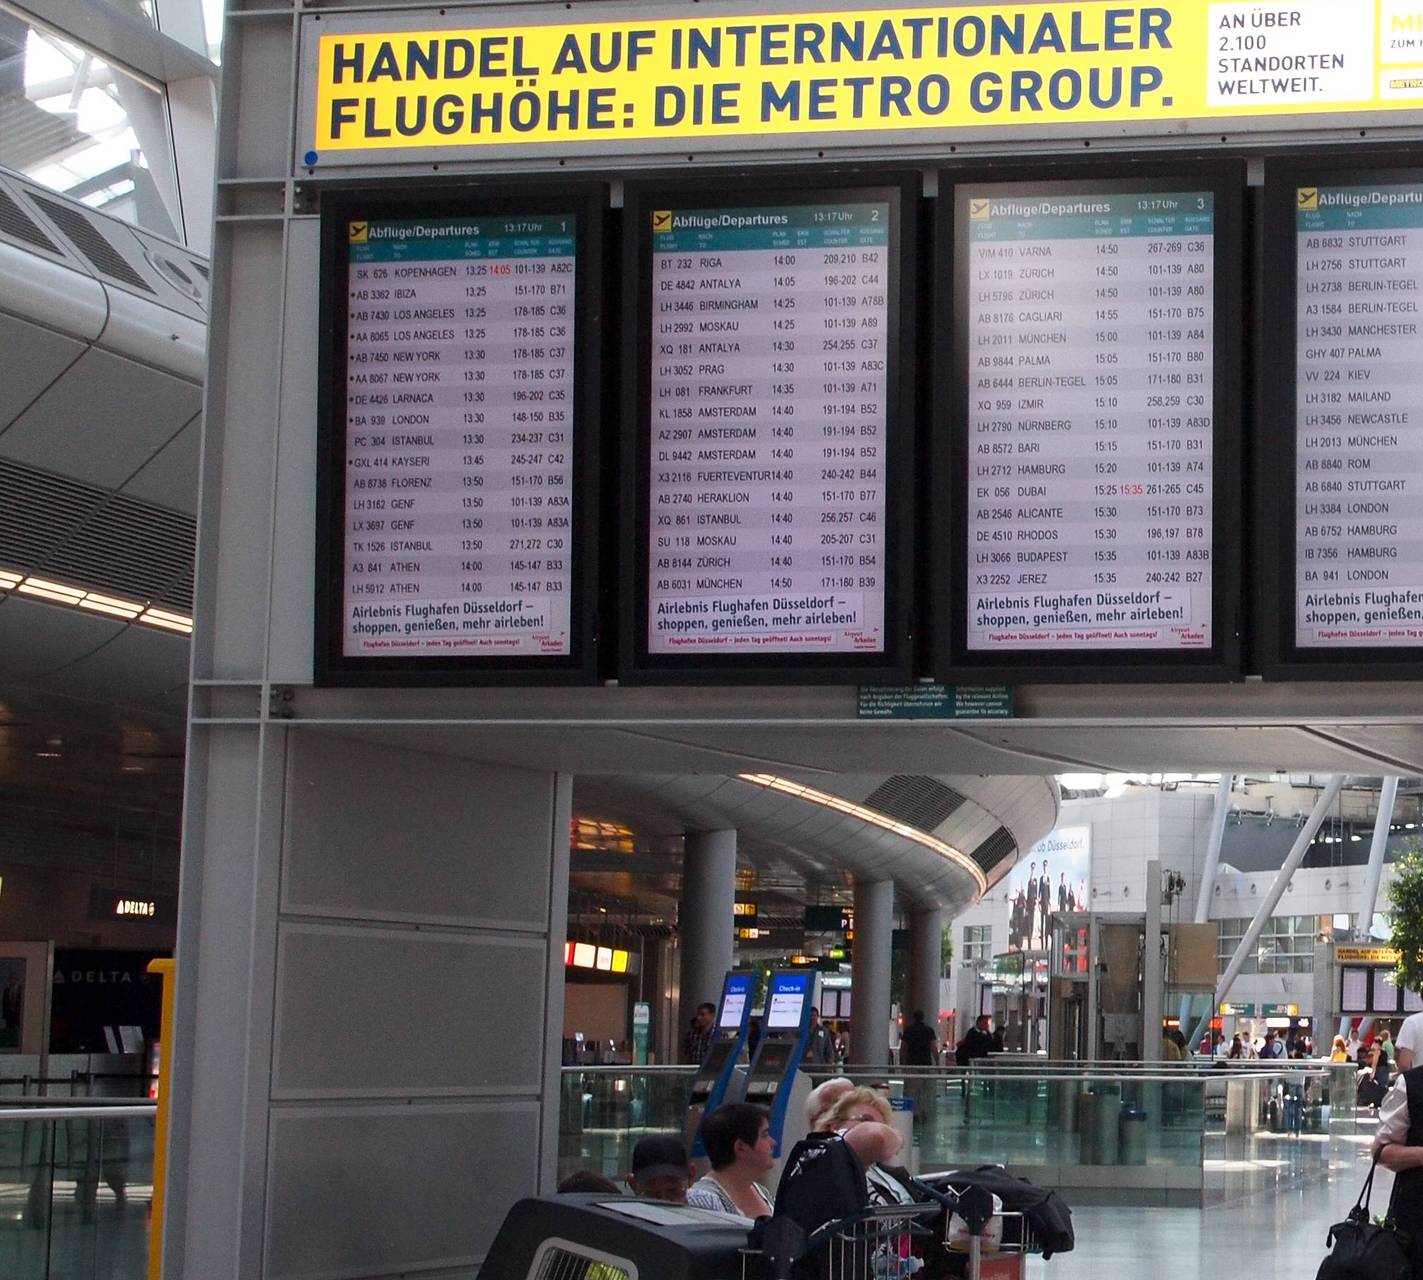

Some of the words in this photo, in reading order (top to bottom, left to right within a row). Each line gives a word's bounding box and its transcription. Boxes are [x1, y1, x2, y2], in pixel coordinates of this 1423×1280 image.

[1219, 13, 1246, 30] AN
[1251, 9, 1301, 29] ÜBER
[332, 36, 539, 84] HANDEL
[551, 31, 657, 75] AUF
[671, 8, 1173, 70] INTERNATIONALER
[1219, 35, 1267, 52] 2.100
[1390, 38, 1416, 48] ZUM
[1217, 54, 1345, 74] STANDORTEN
[1217, 76, 1323, 95] WELTWEIT.
[330, 79, 635, 140] FLUGHÖHE:
[654, 82, 742, 126] DIE
[760, 74, 951, 122] METRO
[969, 66, 1173, 114] GROUP.
[992, 203, 1110, 216] Abflüge/Departures
[1198, 198, 1204, 209] 3
[673, 215, 788, 228] Abflüge/Departures
[871, 211, 879, 221] 2
[369, 225, 479, 239] Abflüge/Departures
[561, 222, 566, 232] 1
[1348, 236, 1406, 246] STUTTGART
[1019, 247, 1052, 256] VARNA
[700, 258, 721, 267] RIGA
[1348, 258, 1406, 269] STUTTGART
[395, 267, 456, 277] KOPENHAGEN
[1019, 268, 1054, 279] ZÜRICH
[700, 279, 741, 288] ANTALYA
[1348, 280, 1418, 291] BERLIN-TEGEL
[394, 290, 416, 298] IBIZA
[1019, 290, 1054, 300] ZÜRICH
[700, 300, 758, 310] BIRMINGHAM
[1348, 303, 1418, 313] BERLIN-TEGEL
[394, 311, 411, 320] LOS
[414, 309, 454, 319] ANGELES
[1019, 312, 1062, 322] CAGLIARI
[700, 322, 739, 331] MOSKAU
[1348, 325, 1416, 335] MANCHESTER
[394, 332, 411, 341] LOS
[413, 330, 454, 340] ANGELES
[1019, 333, 1066, 344] MÜNCHEN
[699, 343, 740, 352] ANTALYA
[1348, 347, 1381, 357] PALMA
[393, 353, 415, 362] NEW
[416, 352, 440, 361] YORK
[1019, 356, 1050, 365] PALMA
[699, 364, 725, 374] PRAG
[393, 374, 414, 383] NEW
[416, 373, 440, 382] YORK
[1348, 370, 1370, 380] KIEV
[1018, 377, 1086, 387] BERLIN-TEGEL
[699, 385, 752, 395] FRANKFURT
[393, 394, 433, 403] LARNACA
[1348, 392, 1391, 402] MAILAND
[1018, 400, 1043, 408] IZMIR
[698, 407, 756, 416] AMSTERDAM
[392, 415, 429, 424] LONDON
[1348, 413, 1408, 424] NEWCASTLE
[1018, 419, 1071, 431] NÜRNBERG
[698, 429, 756, 438] AMSTERDAM
[392, 436, 434, 446] ISTANBUL
[1348, 434, 1397, 446] MÜNCHEN
[1018, 443, 1040, 452] BARI
[698, 450, 756, 459] AMSTERDAM
[392, 457, 429, 466] KAYSERI
[1348, 459, 1370, 468] ROM
[1018, 465, 1065, 474] HAMBURG
[392, 478, 432, 487] FLORENZ
[1348, 481, 1406, 491] STUTTGART
[1018, 487, 1046, 496] DUBAI
[1095, 485, 1117, 495] 15:25
[1146, 485, 1181, 494] 261-265
[1186, 484, 1204, 494] C45
[697, 493, 749, 503] HERAKLION
[391, 499, 416, 508] GENF
[1348, 504, 1389, 513] LONDON
[1017, 508, 1063, 518] ALICANTE
[391, 520, 415, 529] GENF
[697, 515, 740, 524] ISTANBUL
[1017, 531, 1058, 540] RHODOS
[1348, 526, 1397, 535] HAMBURG
[697, 536, 736, 545] MOSKAU
[390, 542, 432, 551] ISTANBUL
[1017, 552, 1068, 562] BUDAPEST
[1347, 548, 1397, 558] HAMBURG
[697, 556, 730, 567] ZÜRICH
[390, 563, 420, 572] ATHEN
[1017, 575, 1047, 584] JEREZ
[1347, 570, 1389, 580] LONDON
[697, 578, 742, 588] MÜNCHEN
[390, 584, 420, 593] ATHEN
[977, 596, 1029, 610] Airlebnis
[1034, 595, 1092, 610] Flughafen
[1097, 592, 1160, 605] Düsseldorf
[1305, 593, 1360, 607] Airlebnis
[352, 604, 401, 618] Airlebnis
[405, 603, 459, 618] Flughafen
[463, 601, 522, 615] Düsseldorf
[657, 601, 708, 615] Airlebnis
[713, 600, 768, 615] Flughafen
[773, 596, 834, 610] Düsseldorf
[977, 615, 1029, 627] shoppen,
[1034, 610, 1092, 625] genießen,
[1096, 611, 1126, 621] mehr
[1130, 606, 1183, 619] airleben!
[1305, 613, 1360, 624] shoppen,
[1365, 607, 1423, 623] genießen,
[353, 623, 401, 634] shoppen,
[405, 618, 458, 633] genießen,
[463, 619, 491, 629] mehr
[495, 616, 544, 628] airleben!
[657, 620, 708, 631] shoppen,
[712, 615, 768, 631] genießen,
[772, 616, 801, 626] mehr
[805, 611, 856, 624] airleben!
[72, 971, 132, 983] DELTA
